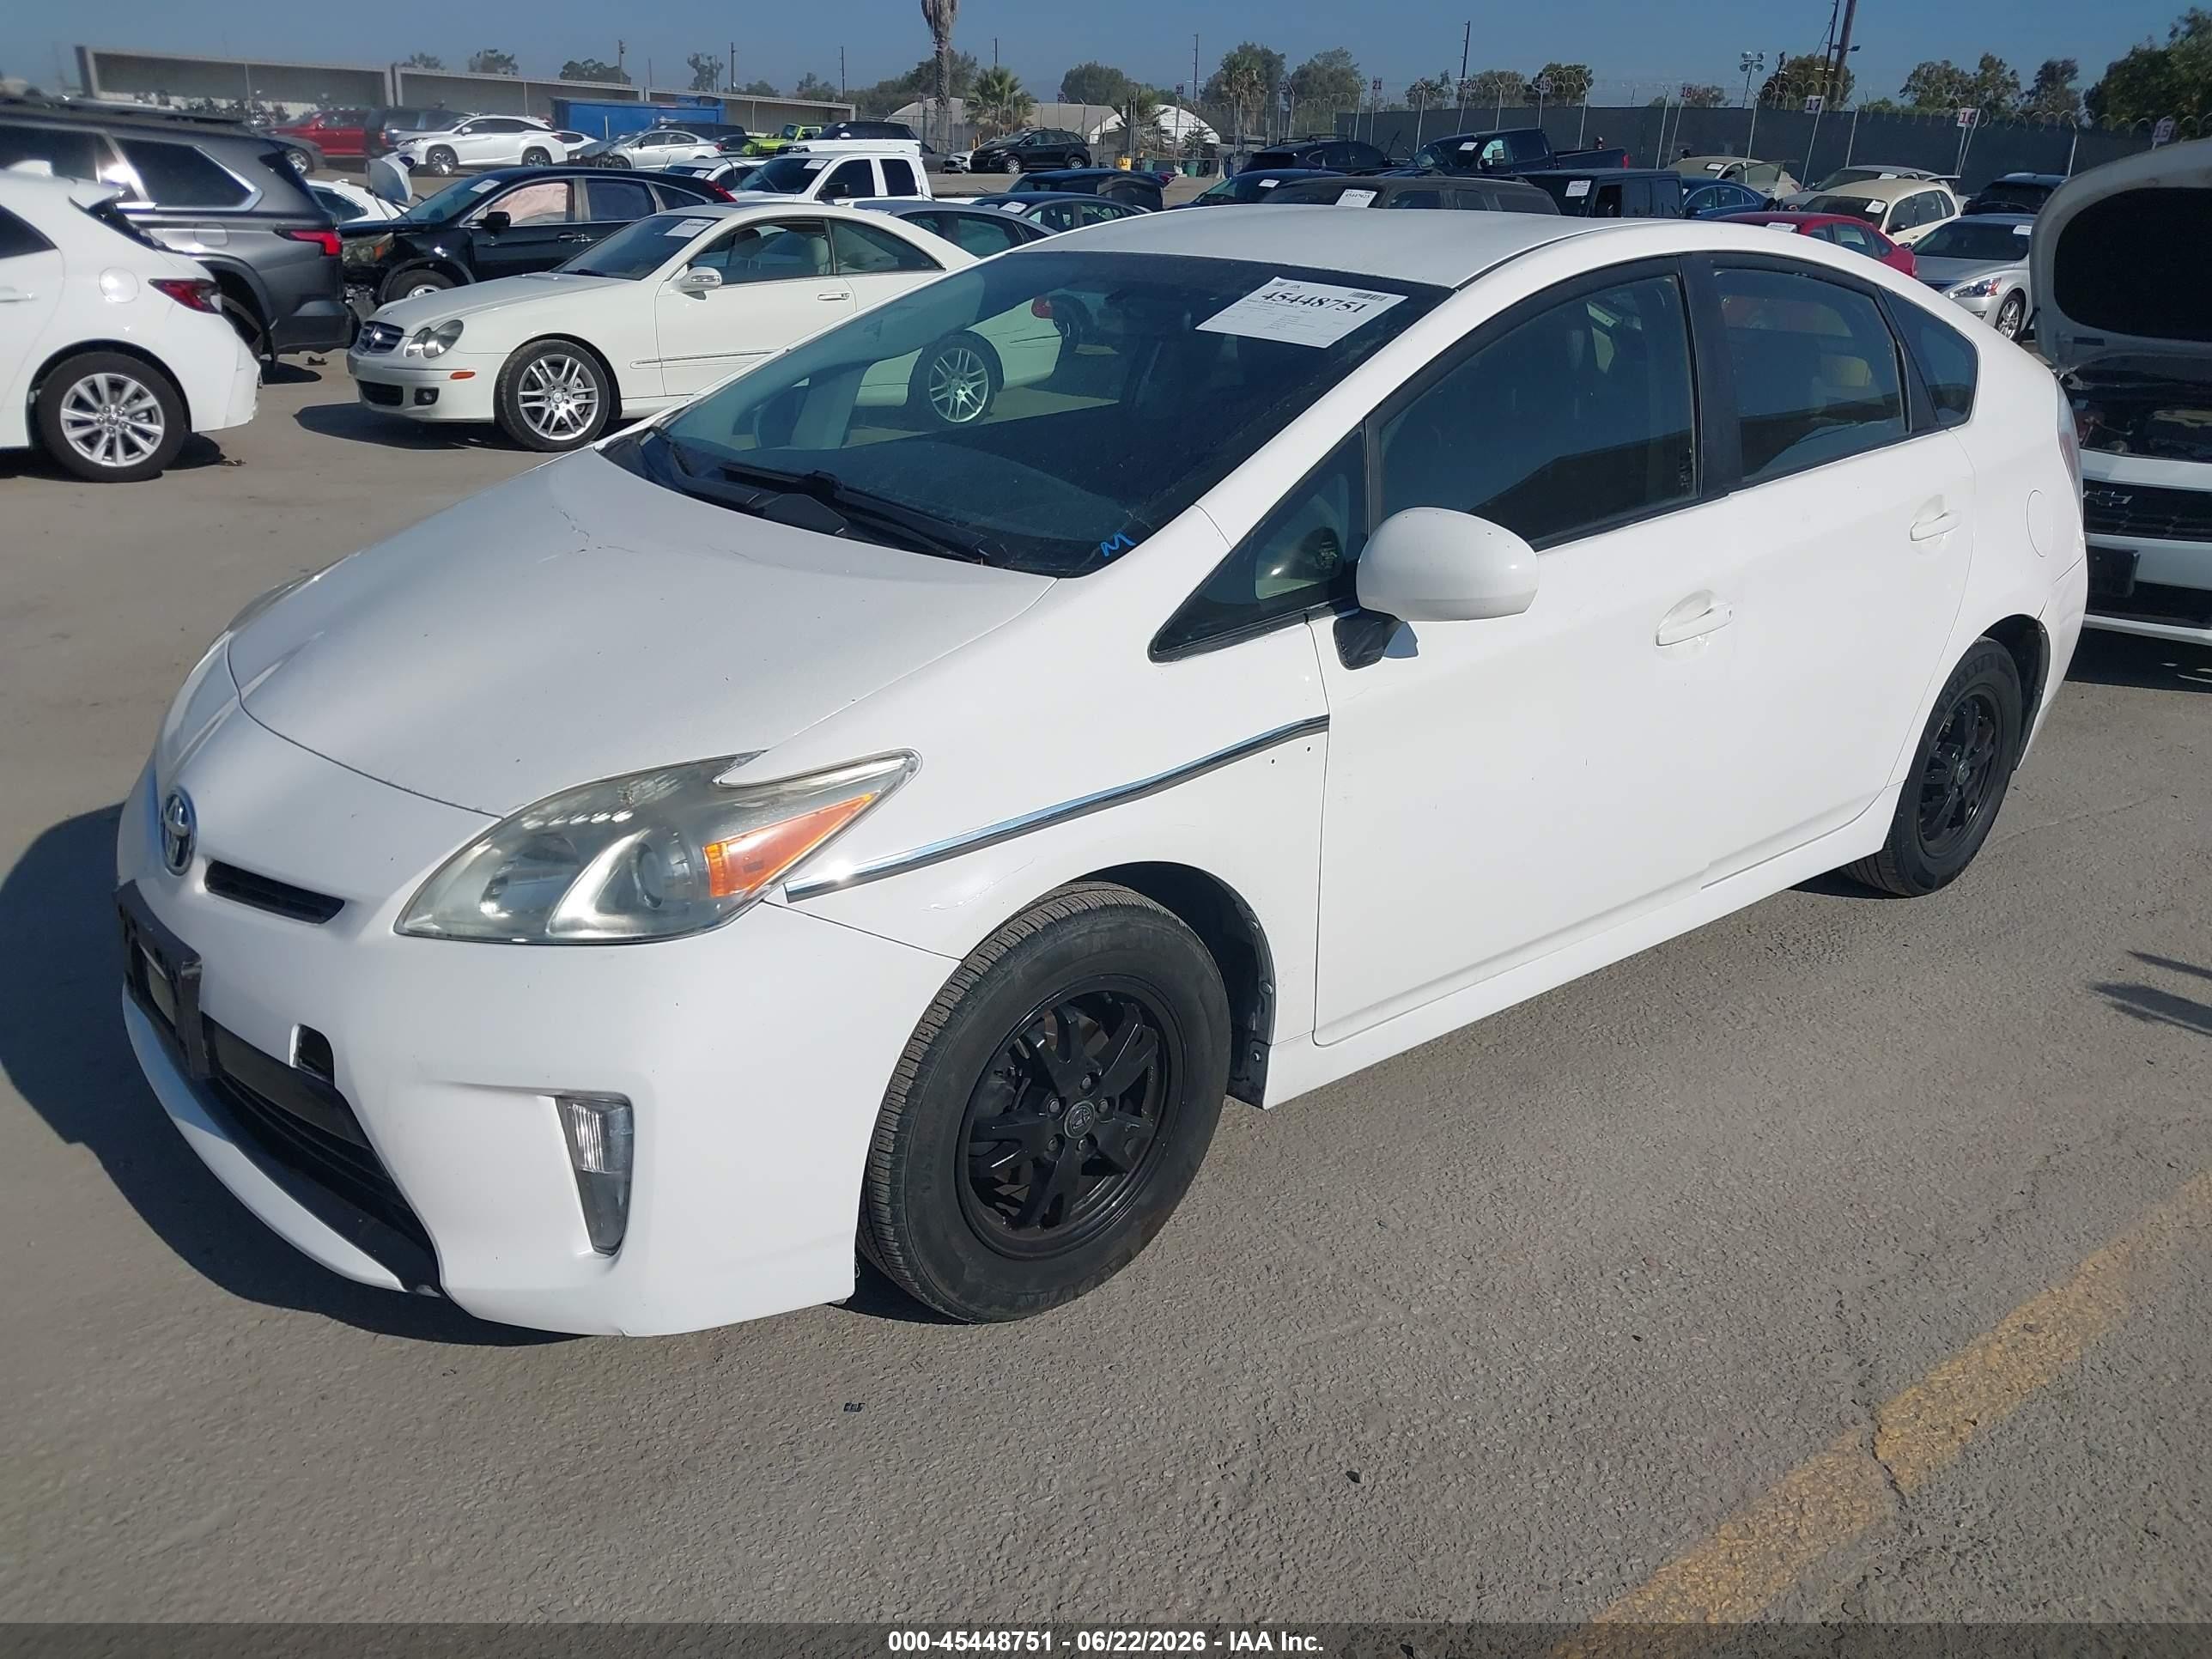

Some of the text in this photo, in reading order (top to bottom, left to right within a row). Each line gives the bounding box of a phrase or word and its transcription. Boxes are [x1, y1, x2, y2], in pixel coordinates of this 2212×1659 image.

[1372, 80, 1382, 90] 21
[1467, 79, 1477, 90] 20
[1540, 79, 1551, 90] 19
[1680, 86, 1692, 98] 18
[1806, 99, 1821, 112] 17
[1959, 112, 1976, 125] 16
[1261, 290, 1368, 313] 45448751
